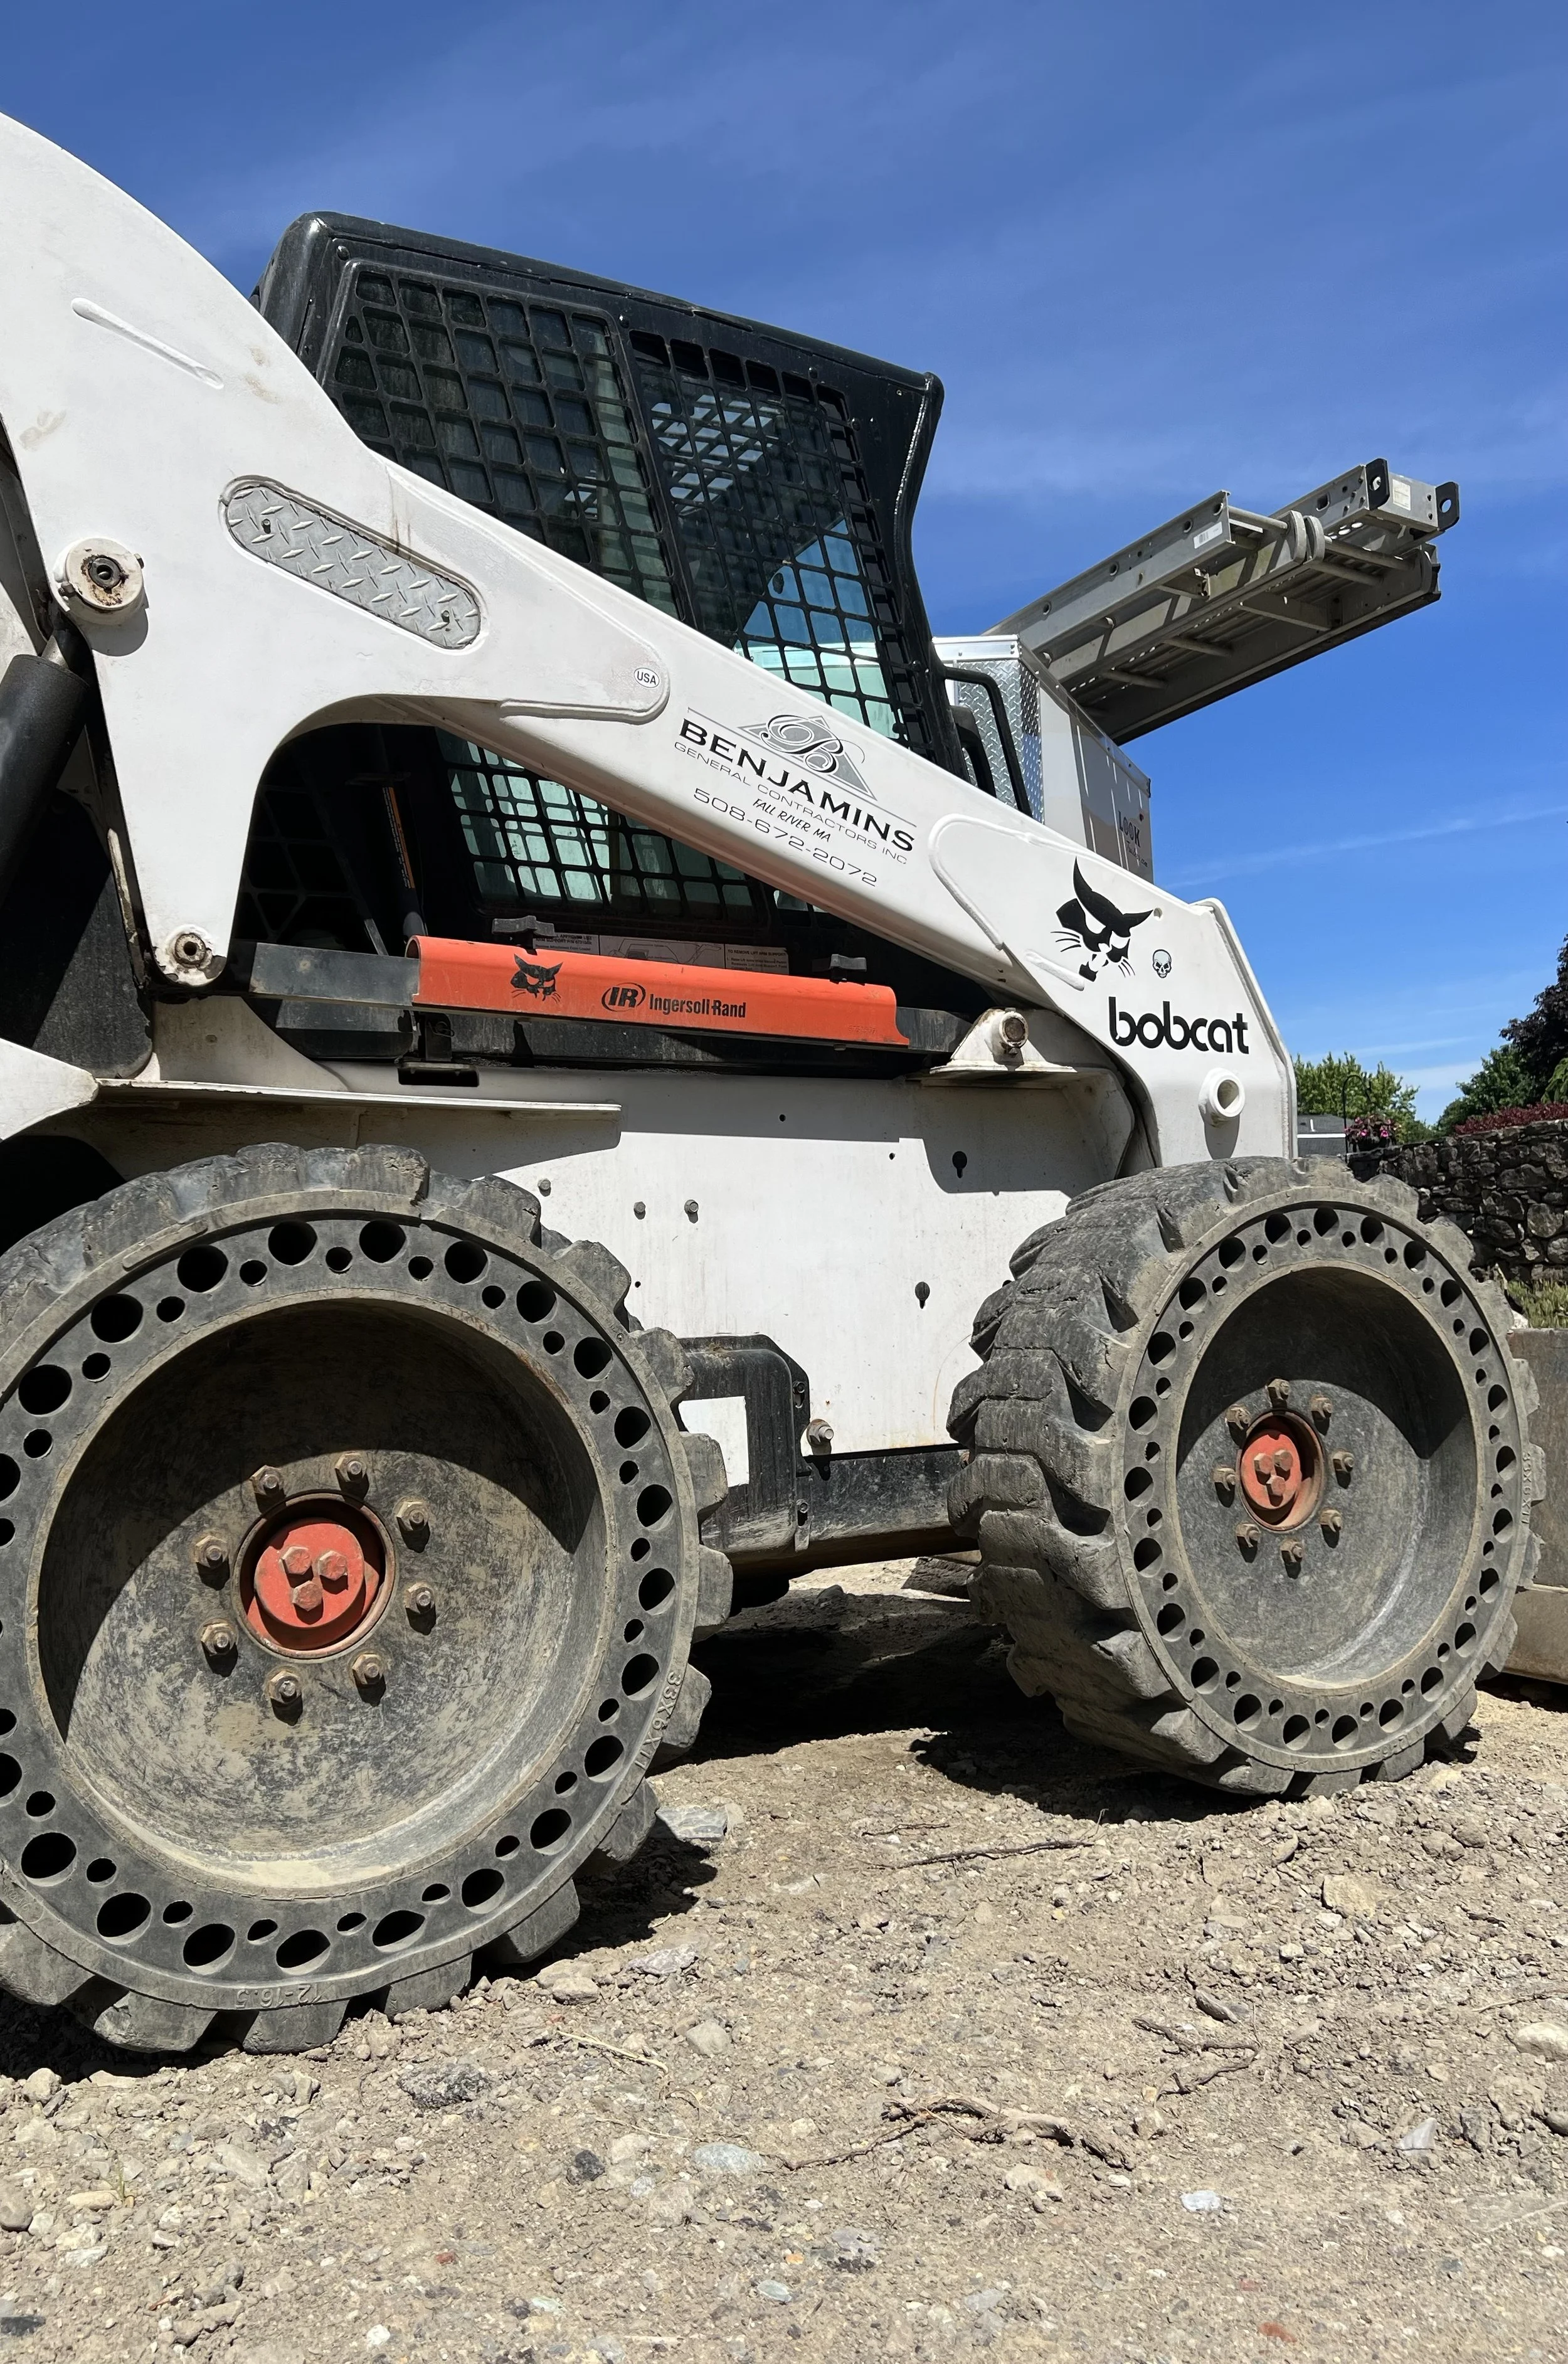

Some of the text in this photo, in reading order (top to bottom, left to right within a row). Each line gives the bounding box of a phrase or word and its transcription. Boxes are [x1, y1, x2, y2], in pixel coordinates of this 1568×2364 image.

[637, 671, 657, 686] USA
[674, 741, 908, 864] GENERAL CONTRACTORS INC
[679, 718, 915, 852] BENJAMINS
[694, 788, 877, 887] 508-672-2072
[753, 798, 831, 843] FALL RIVER MA
[608, 986, 639, 1009] IR
[649, 994, 746, 1018] Ingersoll-Rand
[1108, 996, 1249, 1054] bobcat
[634, 1671, 682, 1770] 33X6X11
[235, 1983, 322, 2009] 12-16.5
